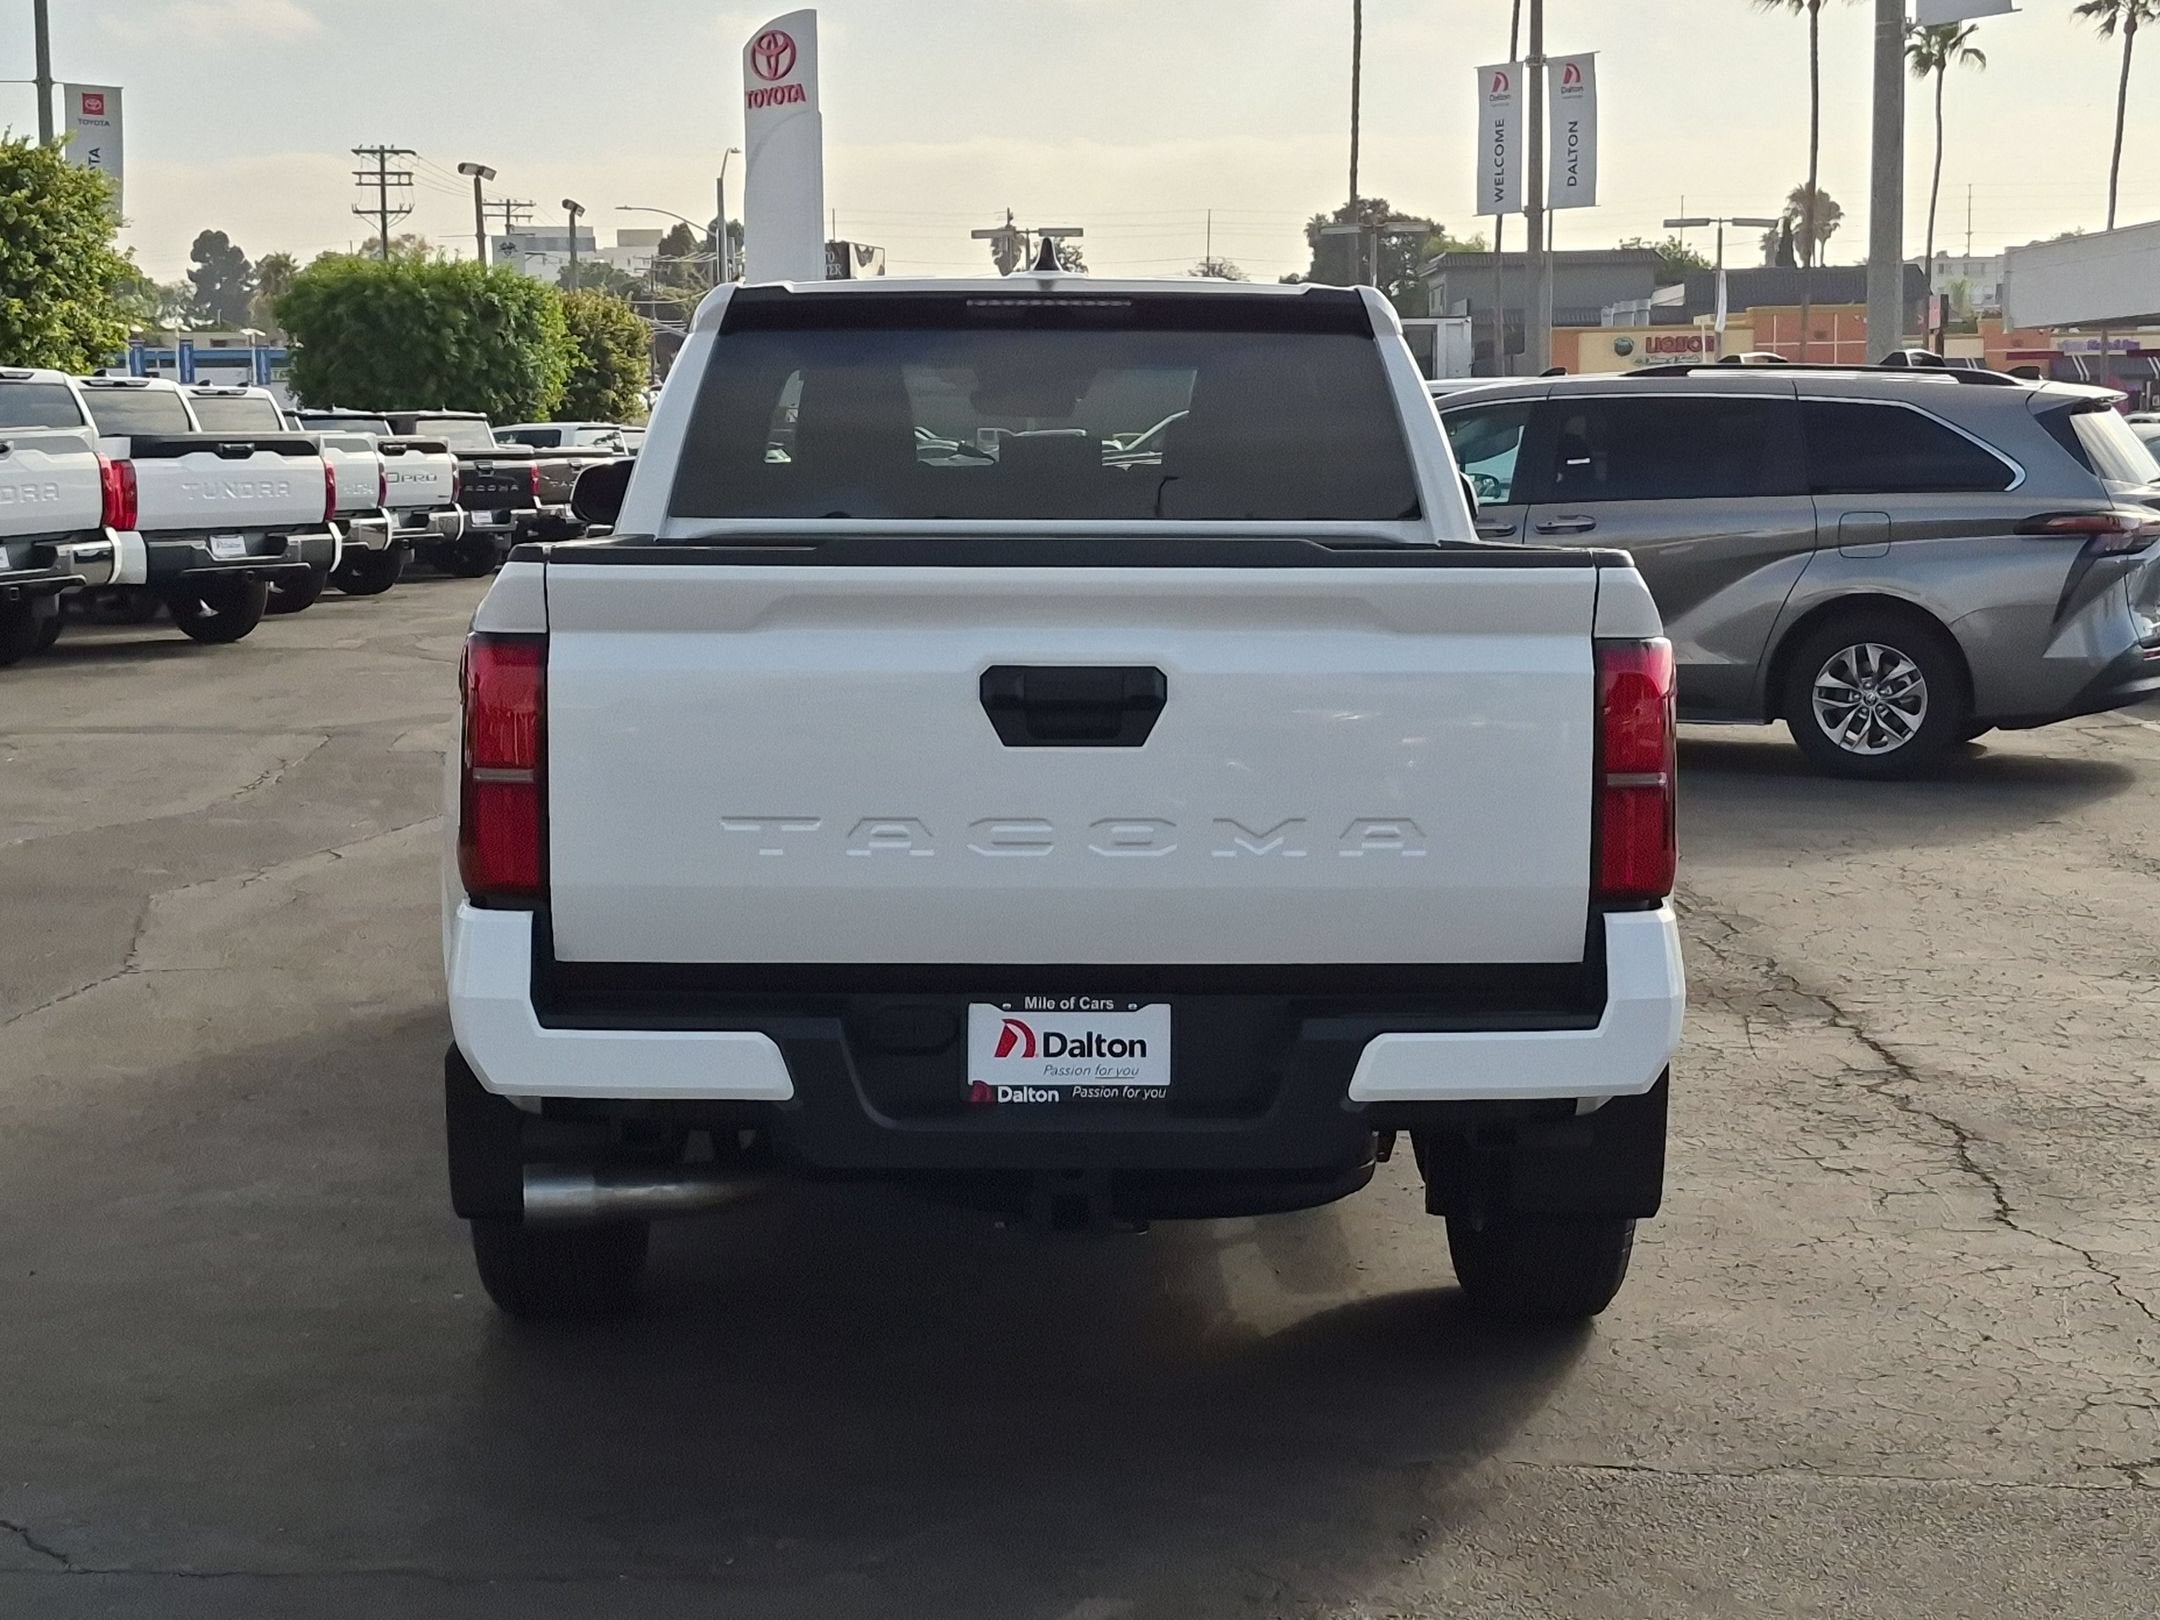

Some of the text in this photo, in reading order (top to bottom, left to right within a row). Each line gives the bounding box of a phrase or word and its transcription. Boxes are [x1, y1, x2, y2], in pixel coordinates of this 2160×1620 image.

[746, 83, 806, 109] TOYOTA
[78, 118, 110, 127] TOYOTA
[1494, 118, 1505, 203] WELCOME
[1567, 120, 1579, 187] DALTON
[182, 480, 291, 500] TUNDRA
[720, 815, 1428, 857] TACOMA
[1024, 996, 1114, 1010] Mile of Cars
[1043, 1031, 1147, 1058] Dalton
[1043, 1063, 1139, 1077] Passion for you
[997, 1085, 1167, 1103] Dalton Passion for you
